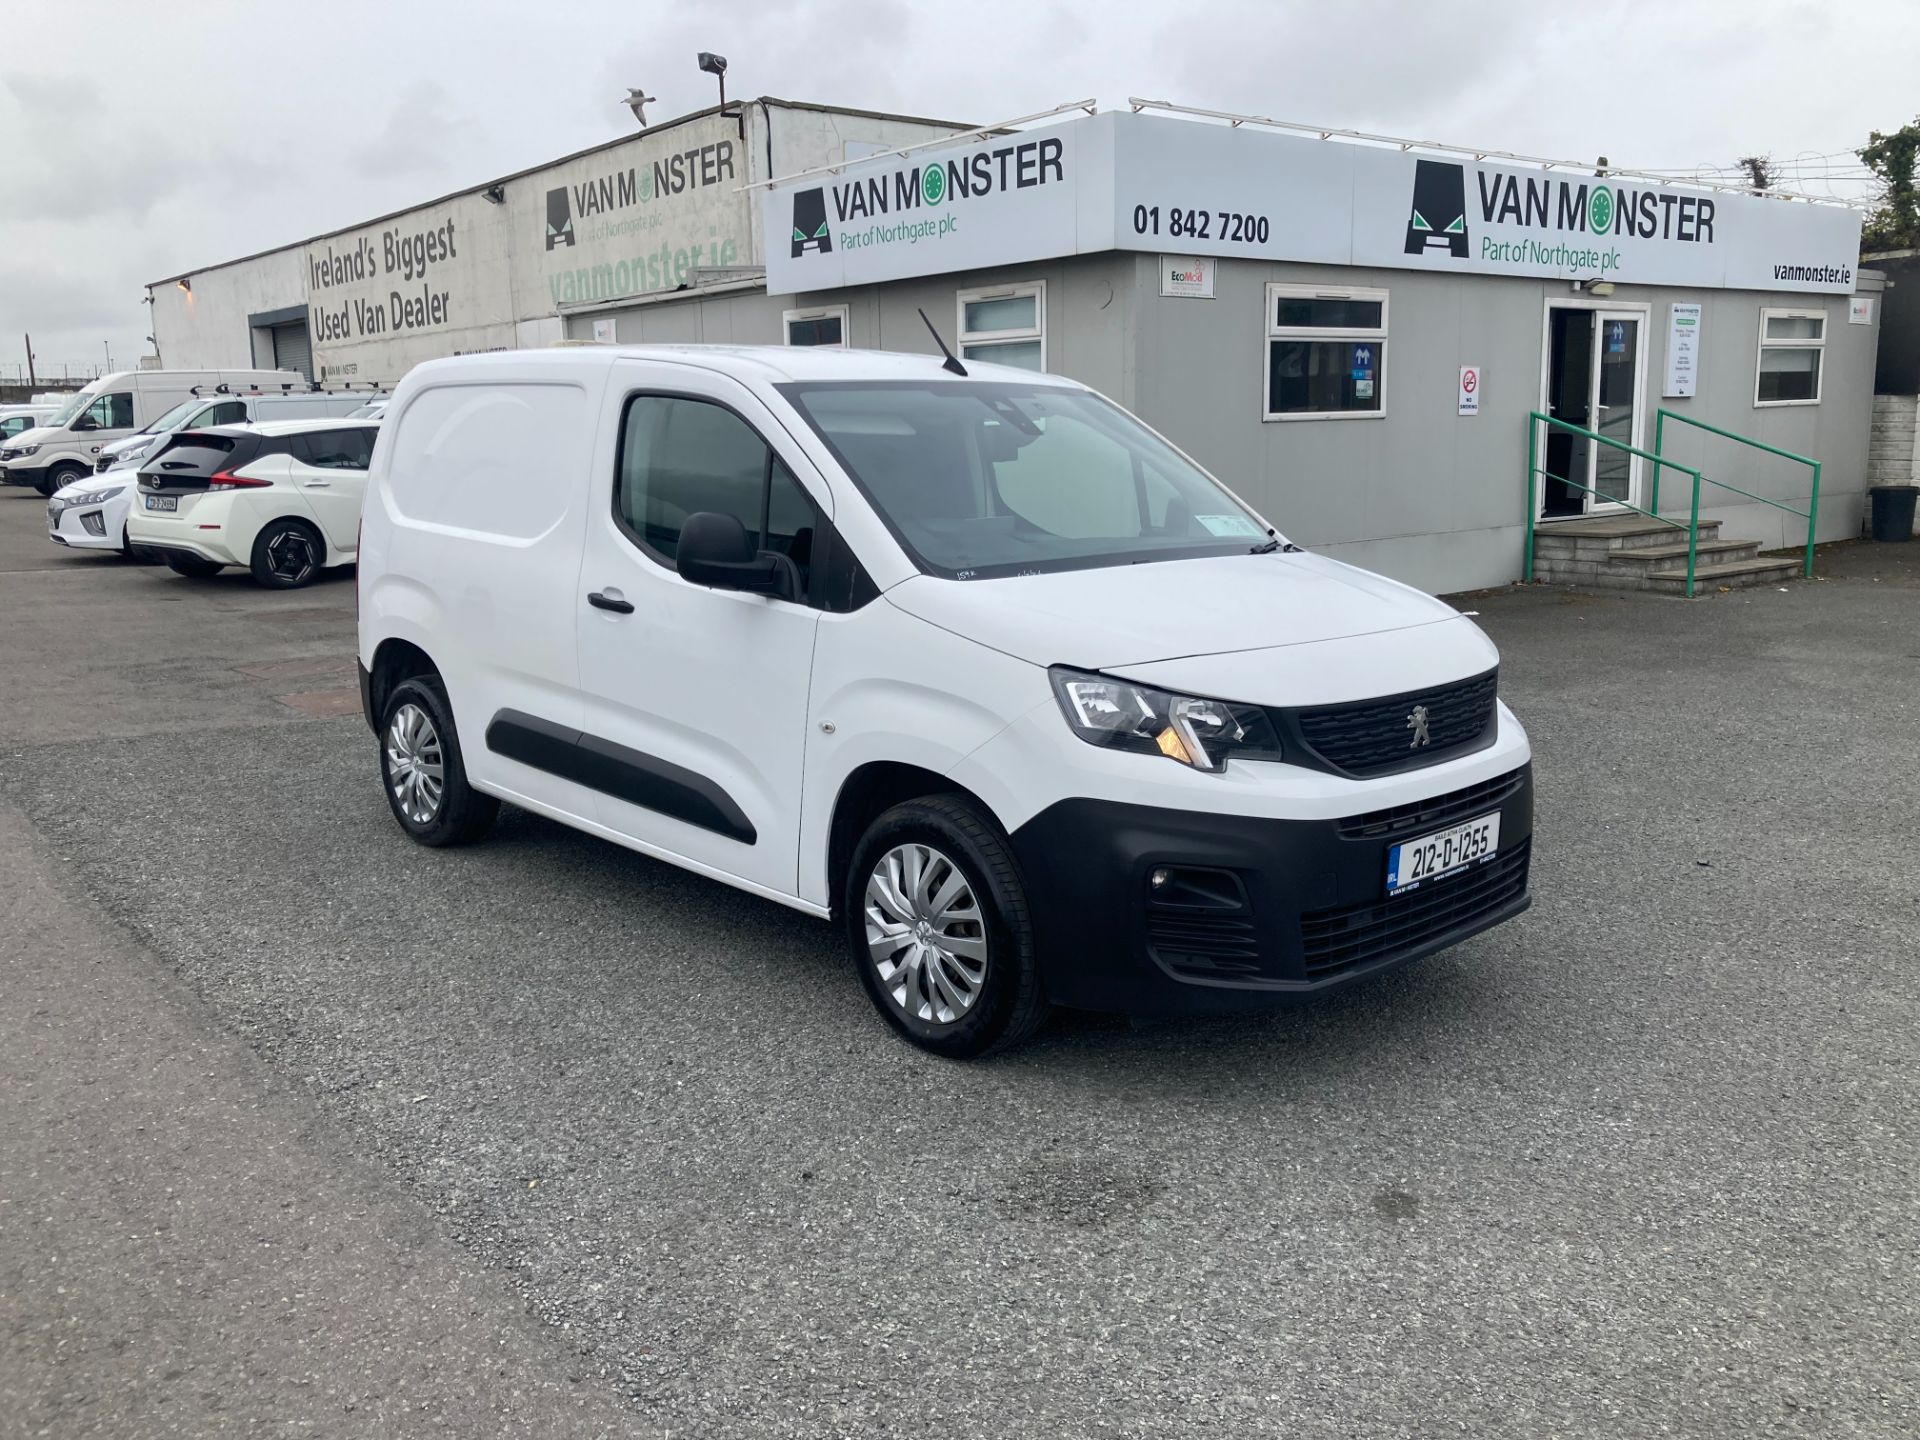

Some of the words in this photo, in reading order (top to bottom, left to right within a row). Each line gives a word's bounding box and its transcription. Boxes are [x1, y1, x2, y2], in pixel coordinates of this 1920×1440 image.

[574, 175, 613, 218] VAN
[617, 140, 734, 208] MONSTER
[832, 175, 888, 222] VAN
[895, 137, 1063, 211] MONSTER
[605, 215, 648, 240] Northgate
[841, 229, 861, 250] Part
[862, 226, 876, 246] of
[876, 221, 936, 243] Northgate
[938, 212, 957, 238] plc
[1134, 204, 1159, 235] 01
[1170, 208, 1210, 239] 842
[1218, 212, 1269, 244] 7200
[1478, 171, 1550, 228] VAN
[1557, 181, 1715, 243] MONSTER
[310, 237, 376, 290] Ireland's
[383, 217, 456, 281] Biggest
[550, 226, 738, 302] vanmonsterie
[1481, 236, 1510, 262] Part
[1512, 238, 1528, 262] of
[1529, 241, 1599, 272] Northgate
[1601, 246, 1620, 274] plc
[1774, 263, 1851, 284] vanmonster.ie
[314, 300, 350, 342] Used
[354, 298, 386, 335] Van
[390, 283, 449, 330] Dealer
[336, 363, 358, 375] MNSTER
[1411, 825, 1489, 879] 212-D-1255
